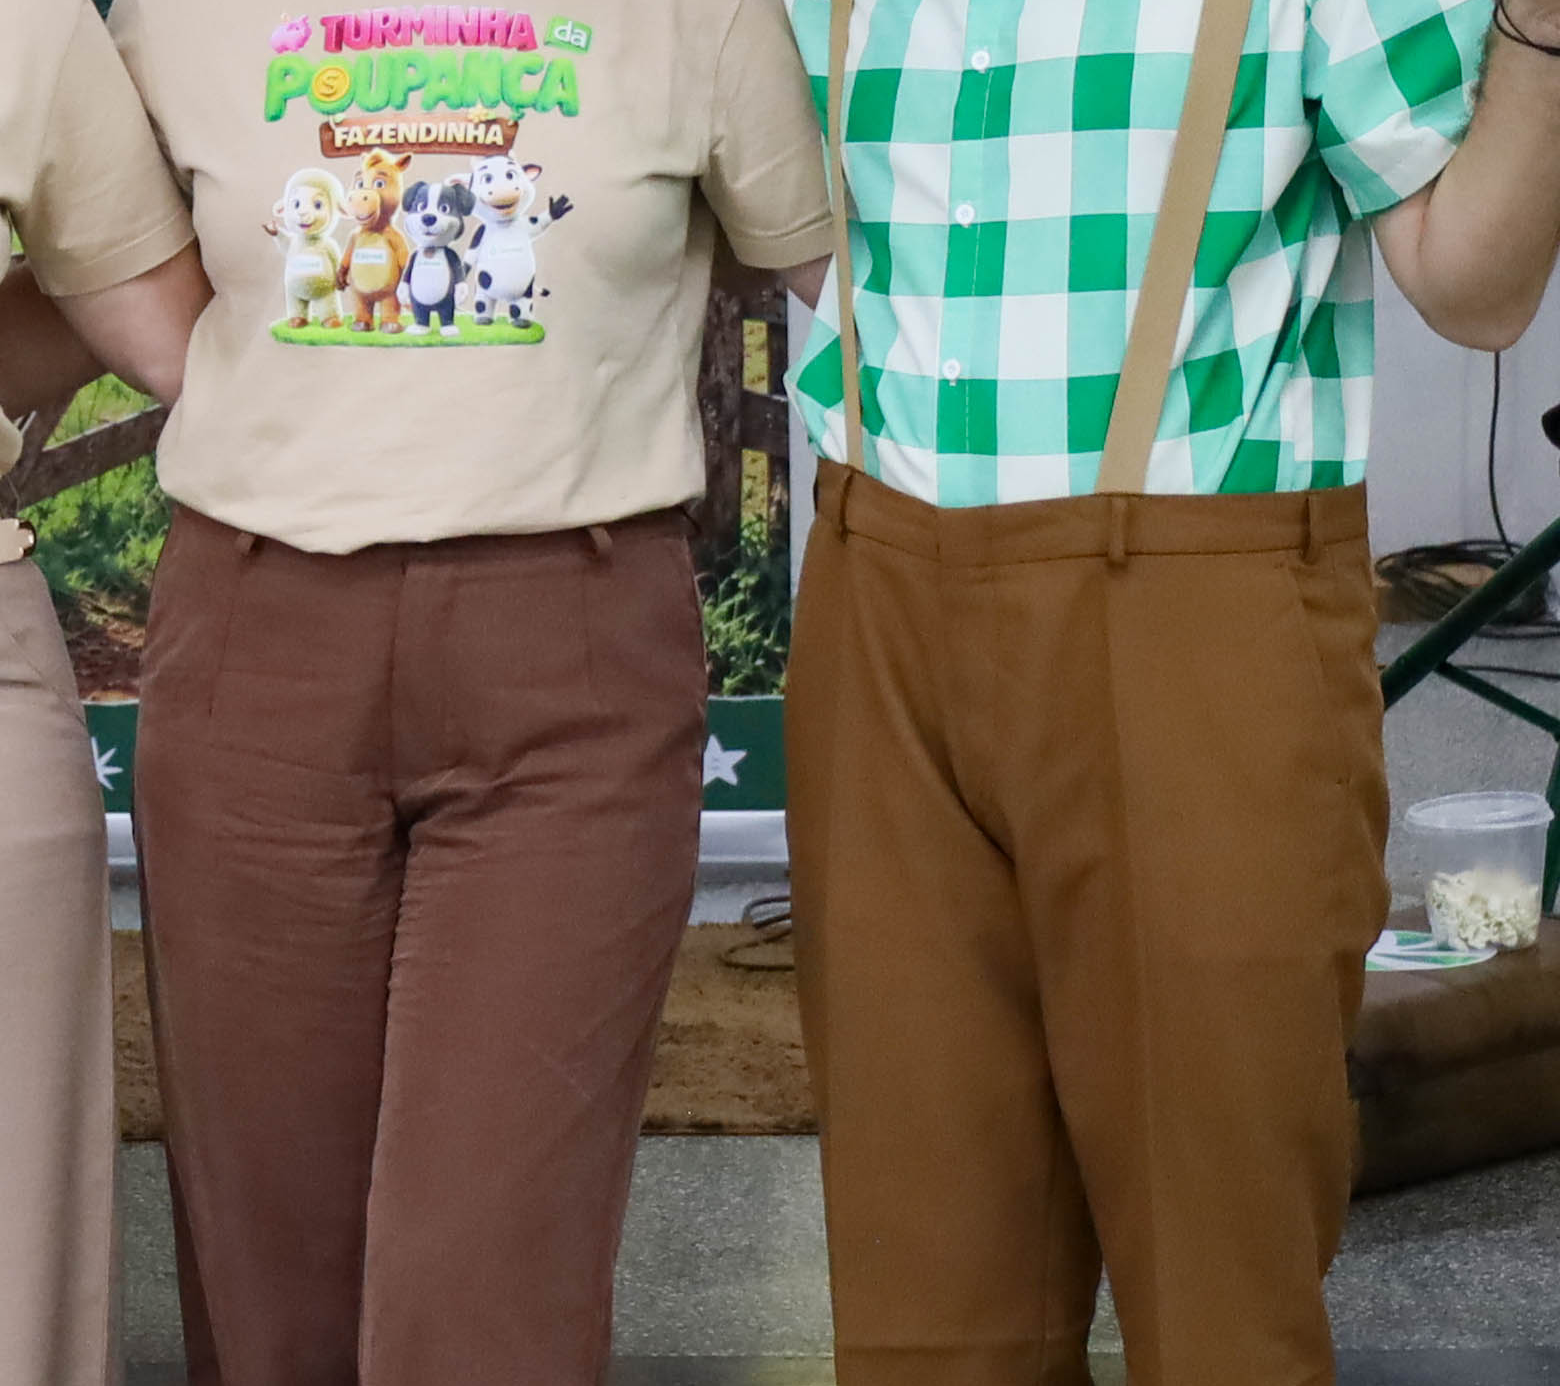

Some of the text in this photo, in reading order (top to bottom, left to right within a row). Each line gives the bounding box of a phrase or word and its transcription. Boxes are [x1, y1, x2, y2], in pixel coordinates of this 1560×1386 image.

[320, 5, 588, 52] TURMINHA da
[263, 50, 580, 122] POUPANÇA
[333, 121, 505, 148] FAZENDINHA
